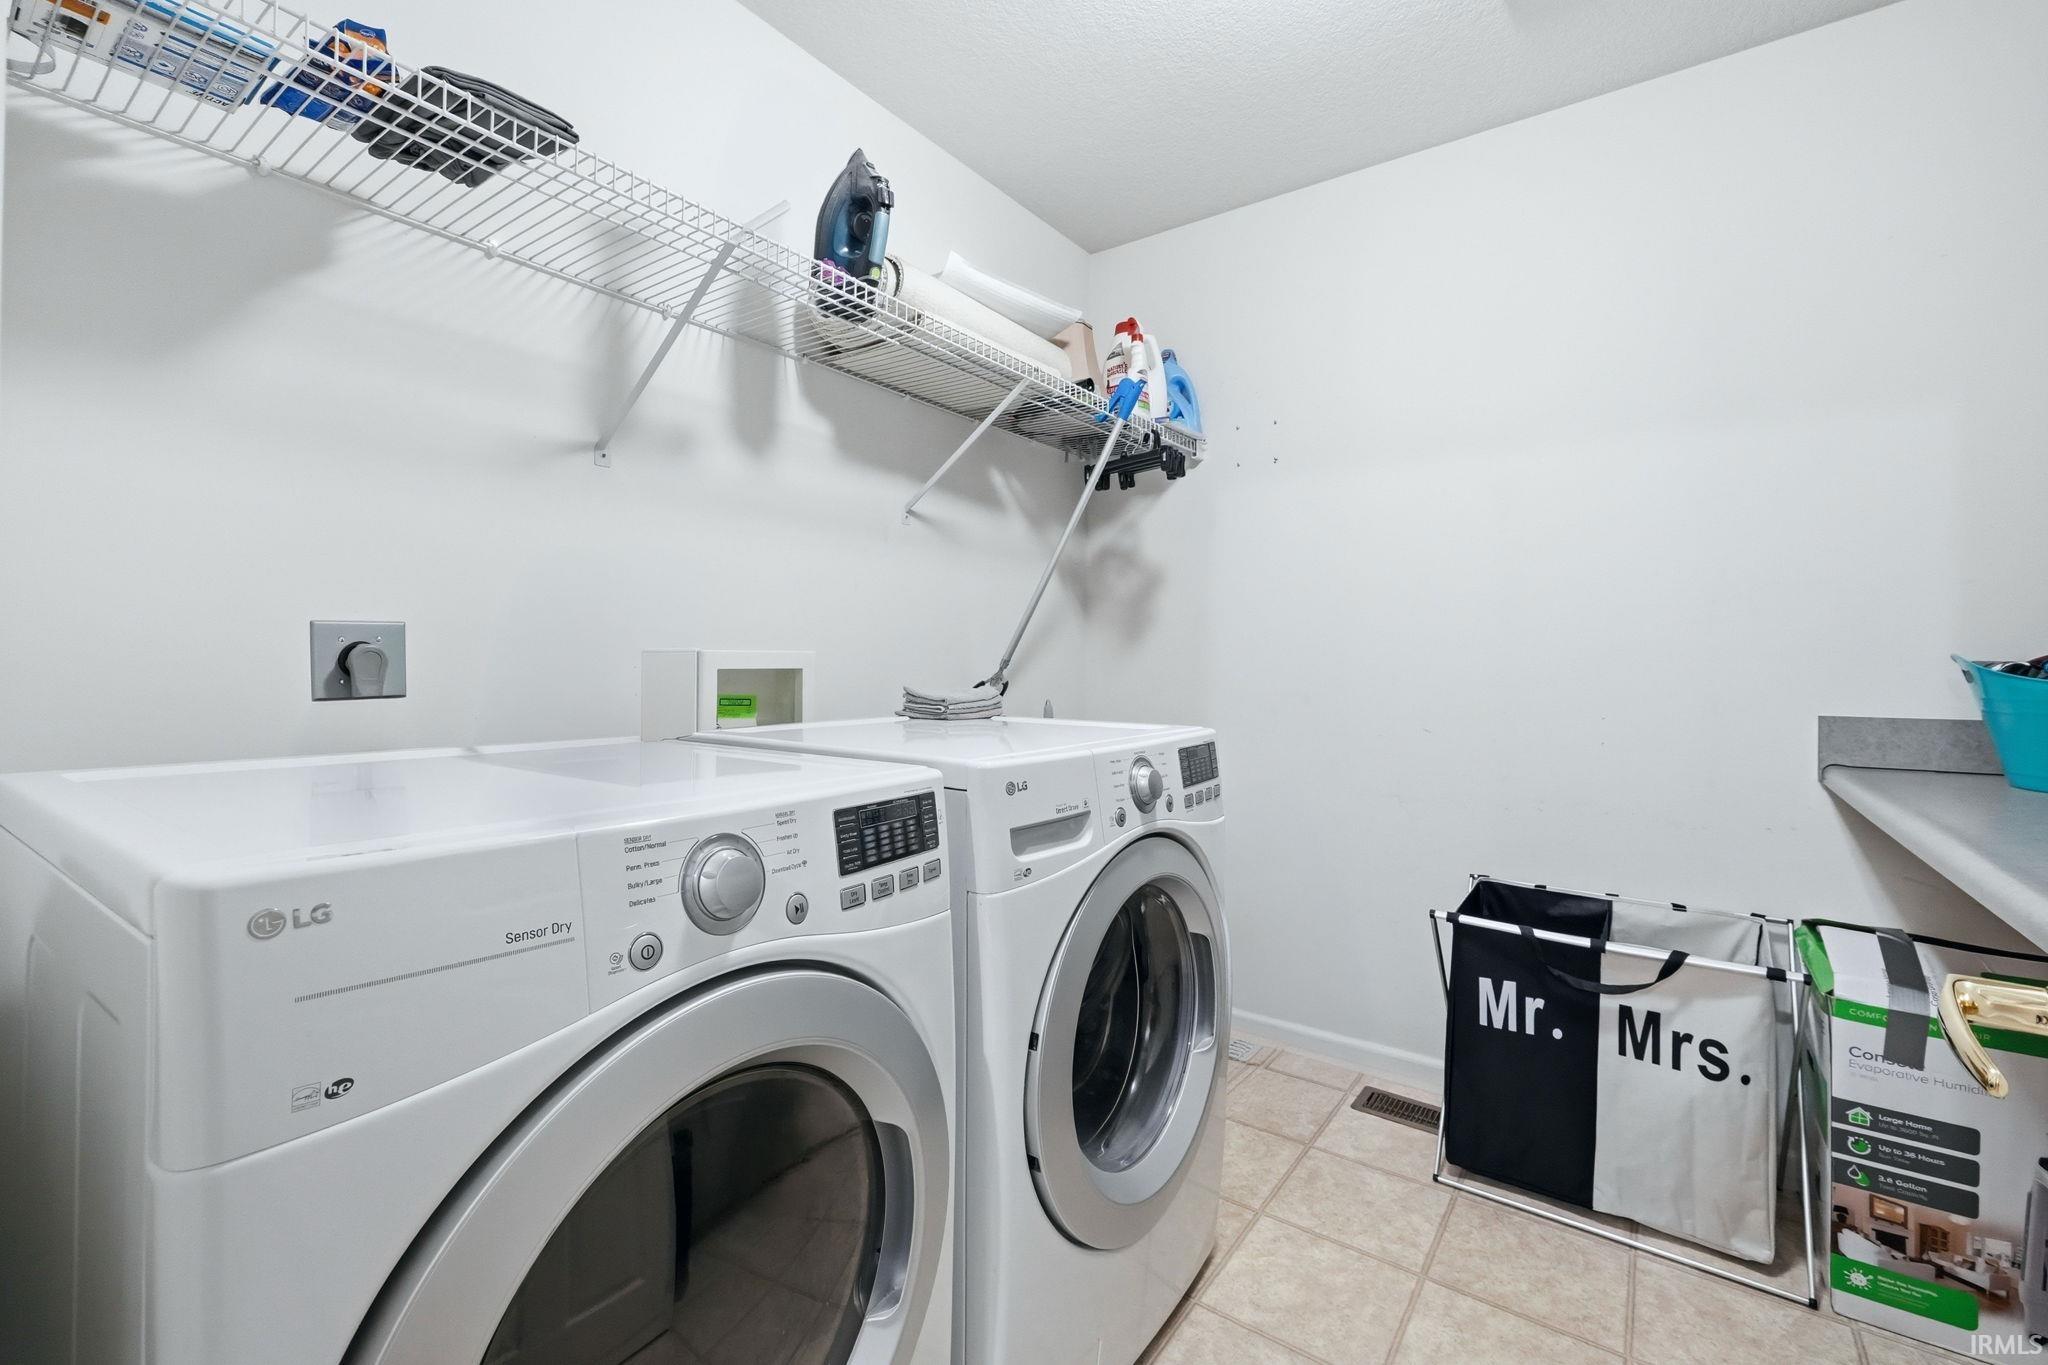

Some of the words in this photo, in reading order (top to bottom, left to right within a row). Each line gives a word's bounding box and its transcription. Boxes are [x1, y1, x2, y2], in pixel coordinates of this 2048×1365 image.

[1017, 780, 1028, 792] LG
[292, 902, 333, 929] LG
[505, 926, 549, 944] Sensor
[551, 922, 573, 935] Dry
[1478, 976, 1563, 1040] Mr.
[1618, 1003, 1751, 1086] Mrs.
[1848, 1059, 1929, 1084] Evaporative
[1878, 1114, 1903, 1125] Large
[1905, 1120, 1933, 1132] Home
[1878, 1144, 1891, 1153] Up
[1918, 1154, 1946, 1166] Hours
[1895, 1179, 1928, 1193] Gallon
